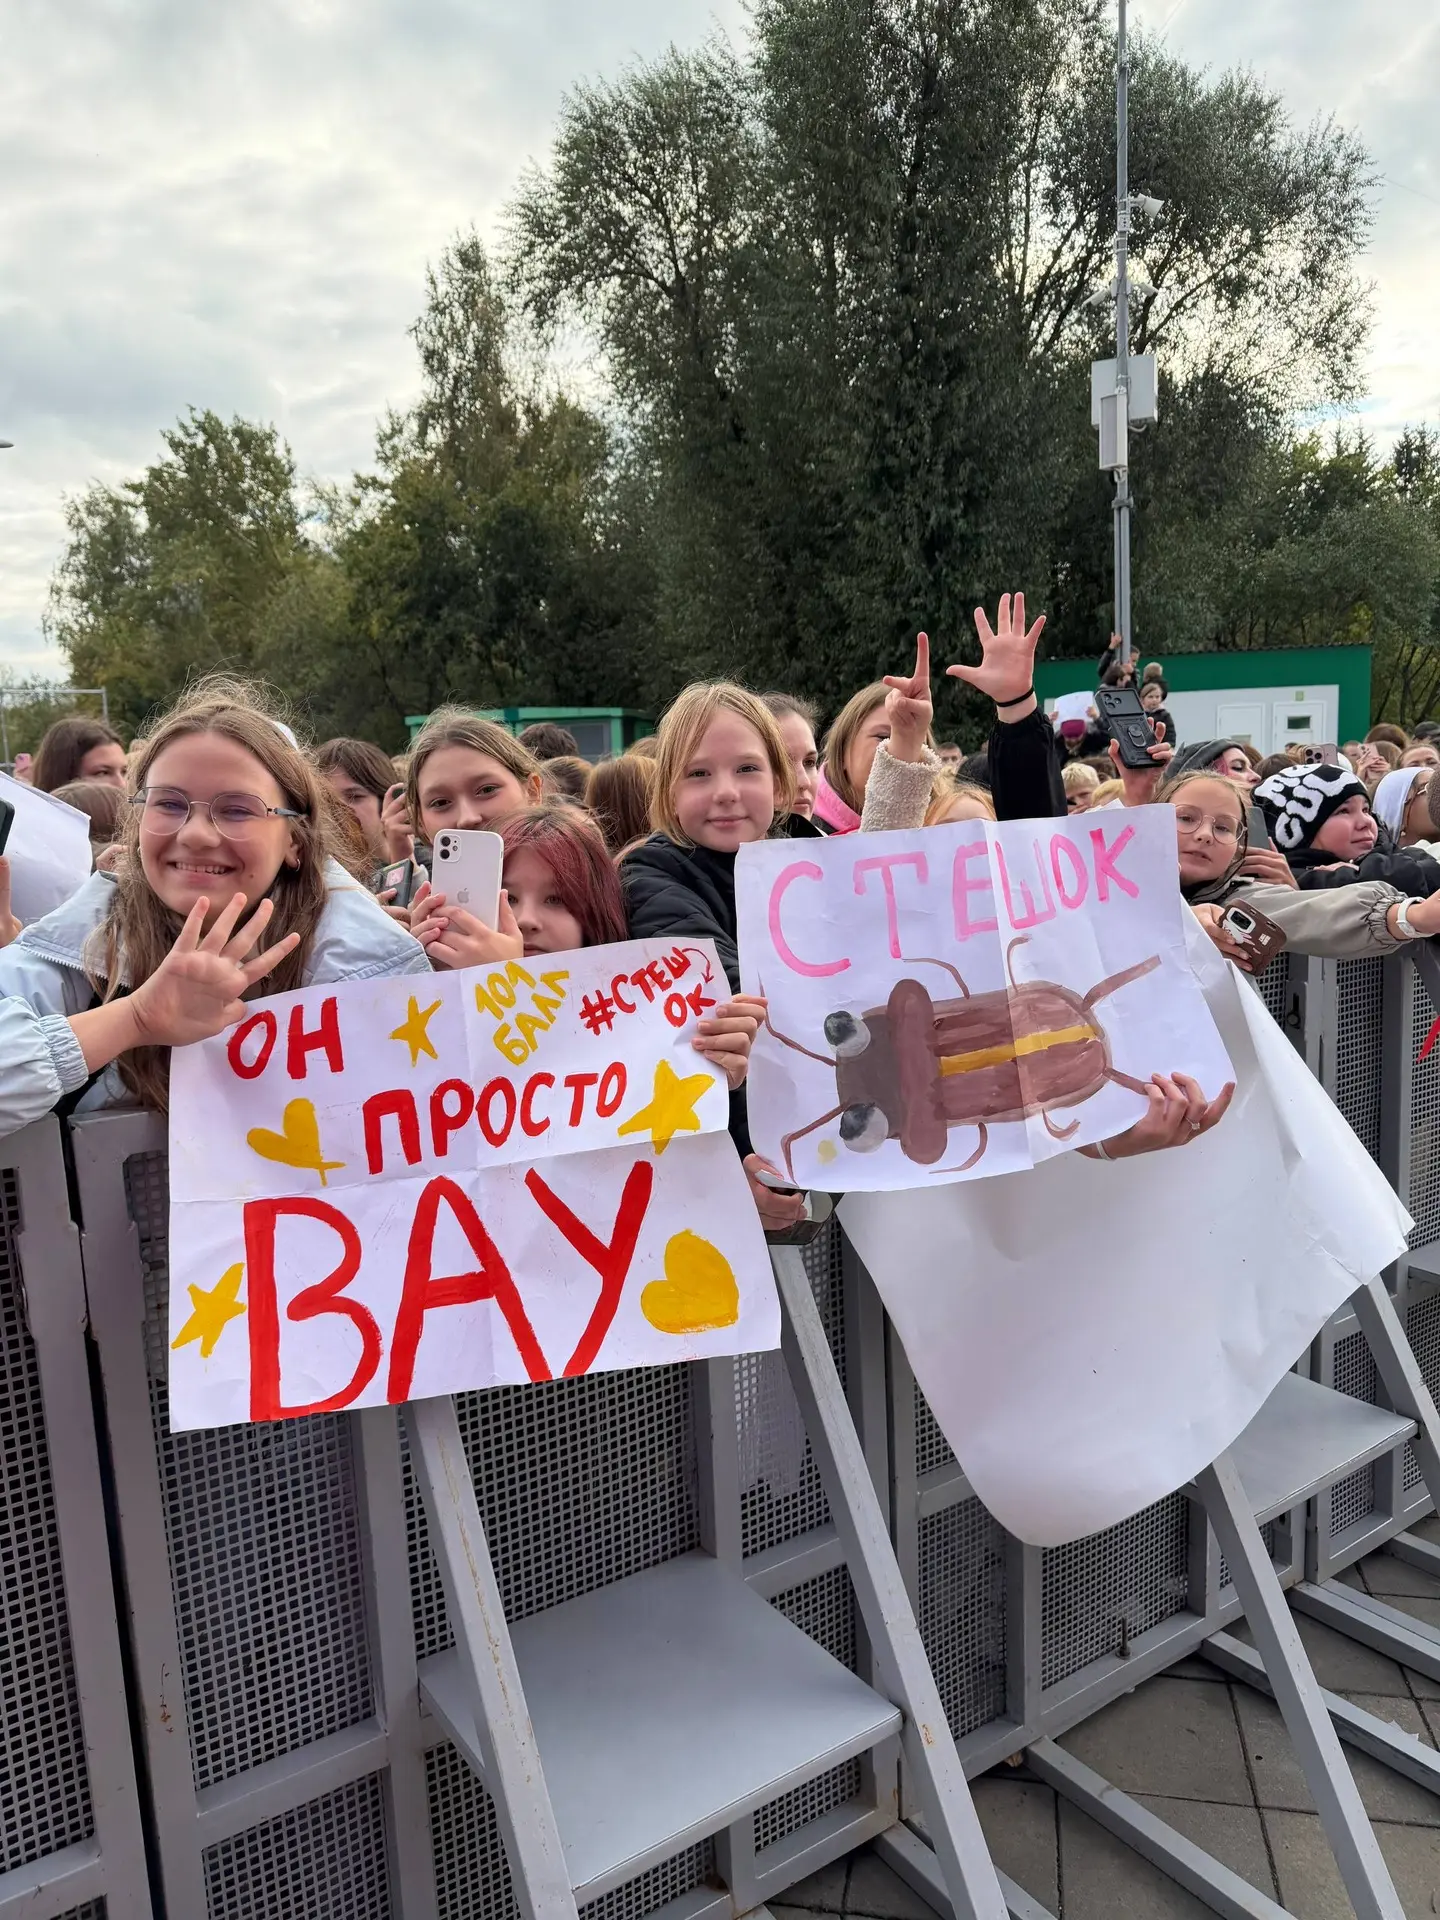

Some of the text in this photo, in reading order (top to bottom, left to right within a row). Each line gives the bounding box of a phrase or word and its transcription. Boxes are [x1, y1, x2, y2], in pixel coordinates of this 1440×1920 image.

[769, 824, 1140, 978] СТЕШОК
[474, 961, 537, 1021] 101
[492, 970, 570, 1067] БАЛЛ
[578, 946, 692, 1036] #СТЕШ
[663, 983, 717, 1028] ОК
[226, 997, 344, 1080] ОН
[362, 1061, 627, 1175] ПРОСТО
[243, 1160, 654, 1423] ВАУ
